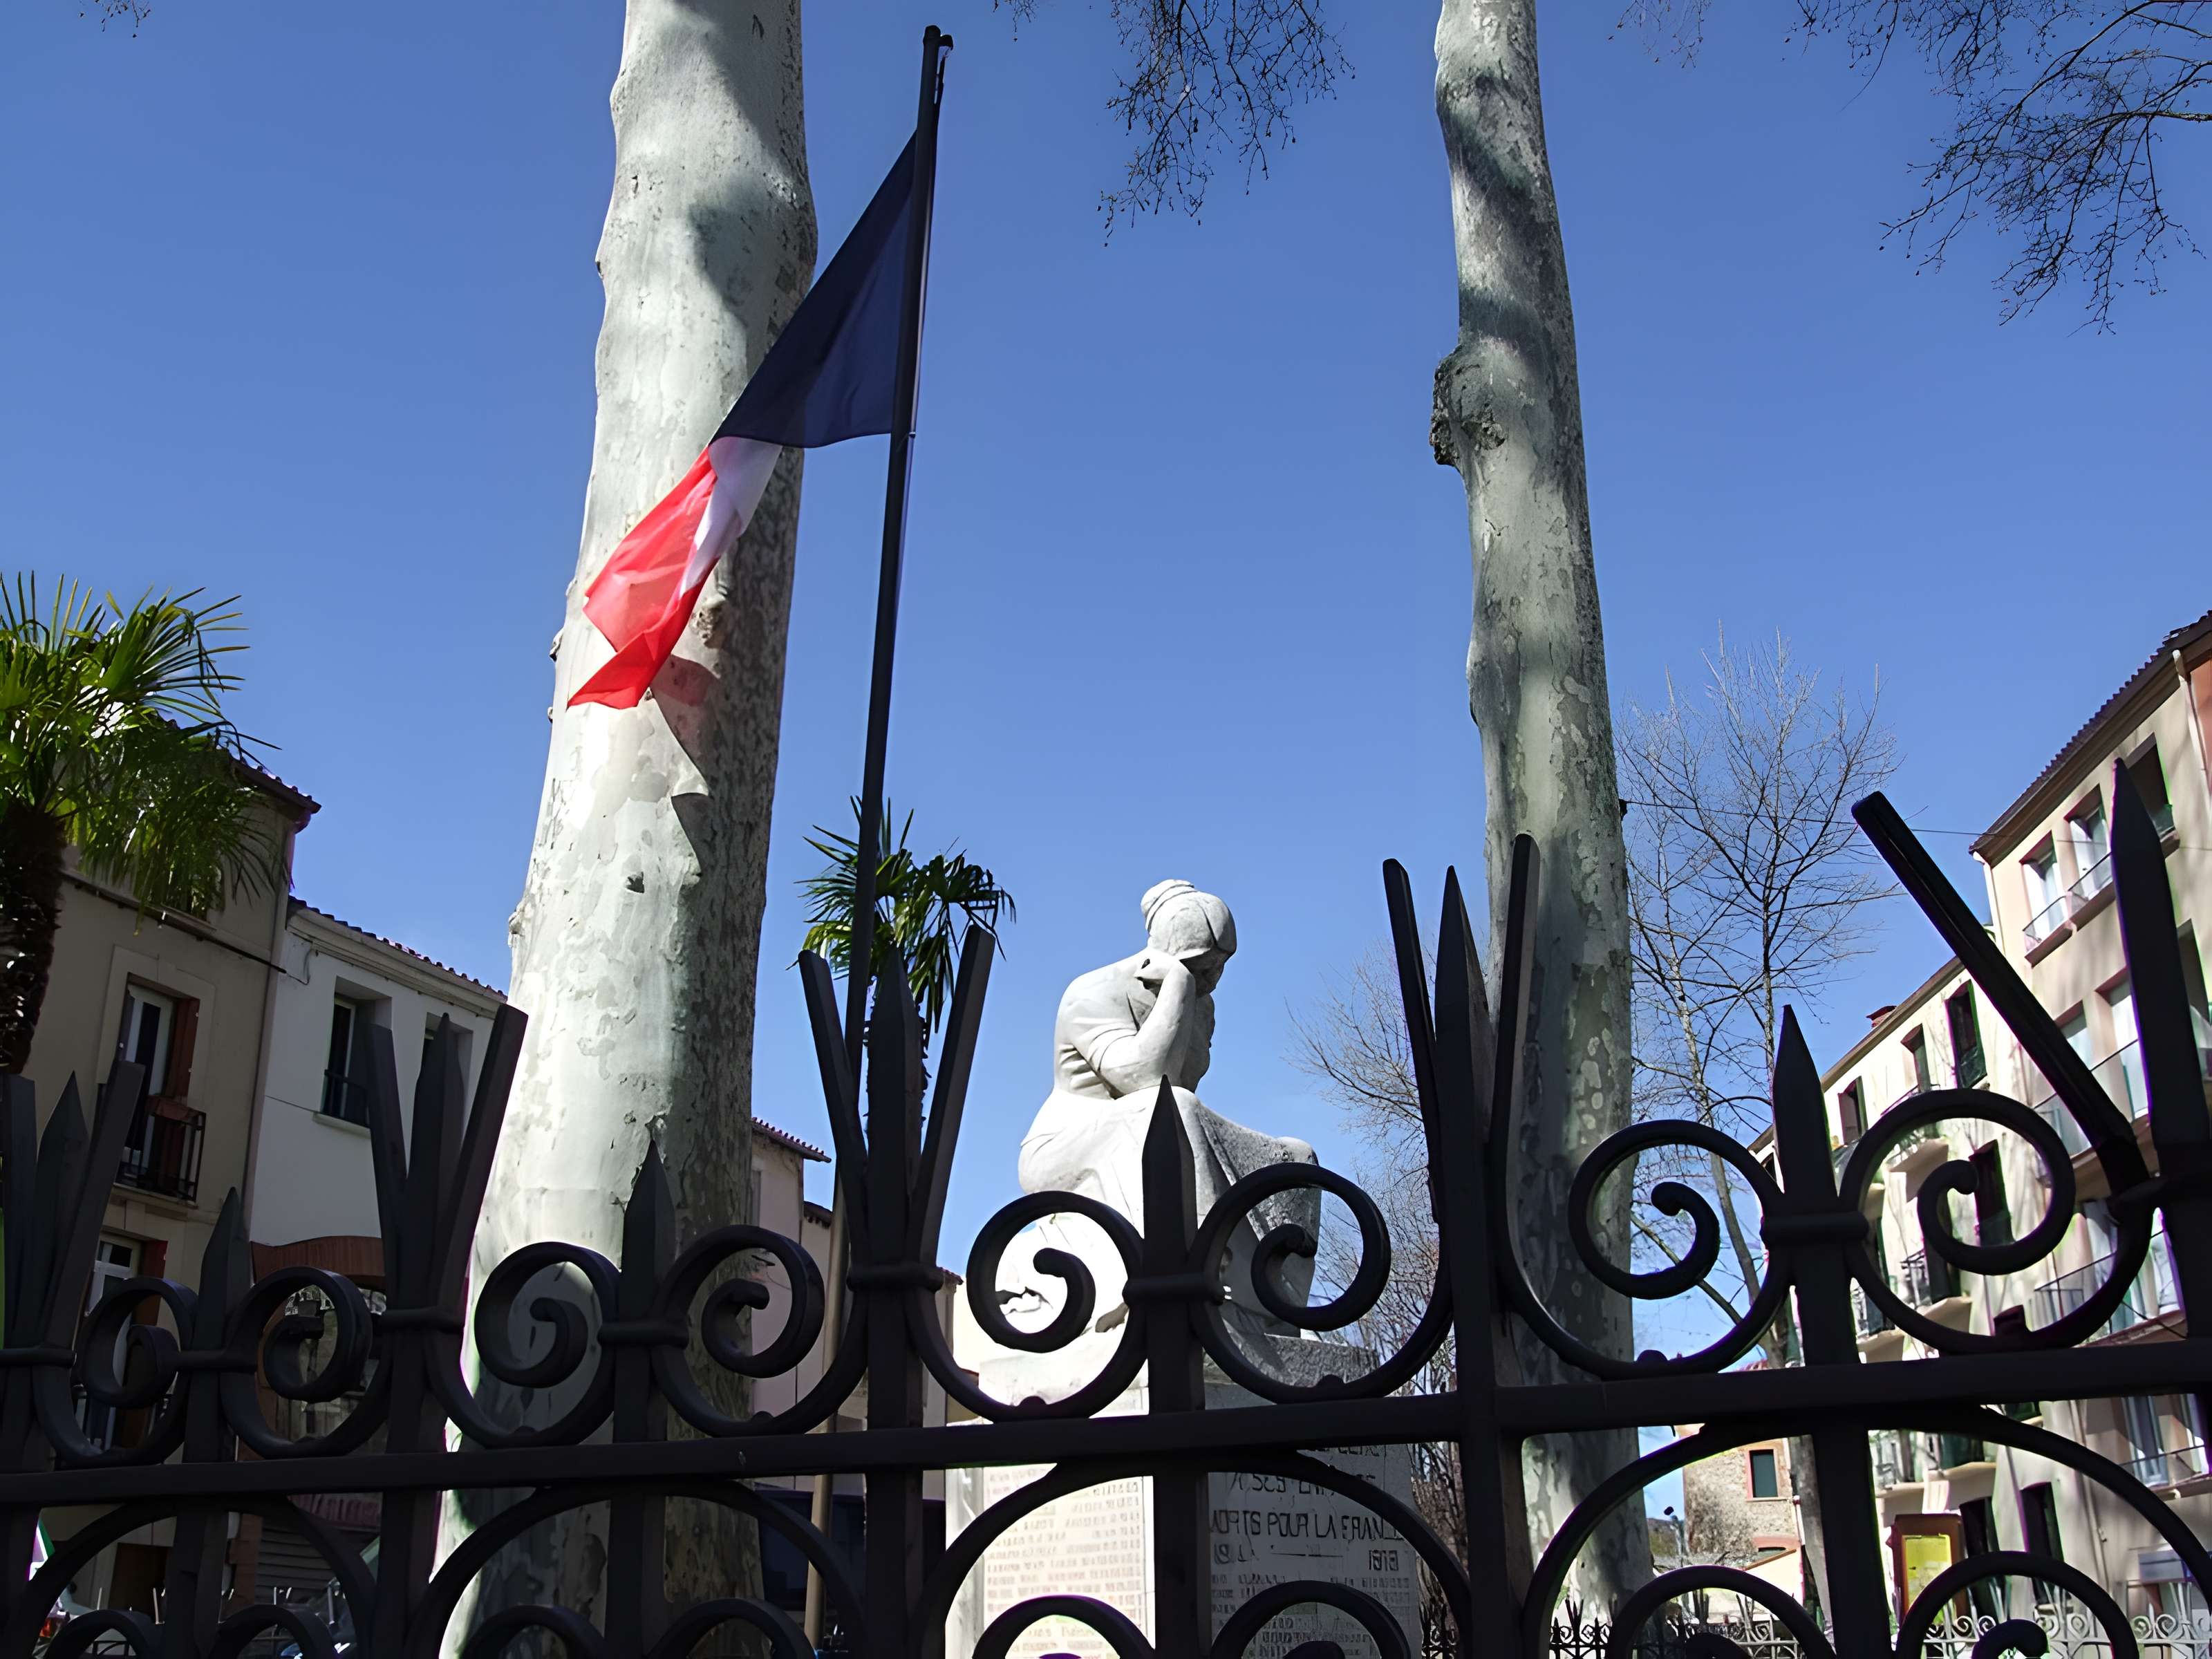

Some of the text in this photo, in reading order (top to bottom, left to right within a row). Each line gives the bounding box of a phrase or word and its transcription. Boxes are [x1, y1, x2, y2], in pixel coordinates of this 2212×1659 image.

[1267, 1512, 1309, 1538] POUR
[1315, 1513, 1337, 1539] LA
[1341, 1515, 1405, 1541] FRAN
